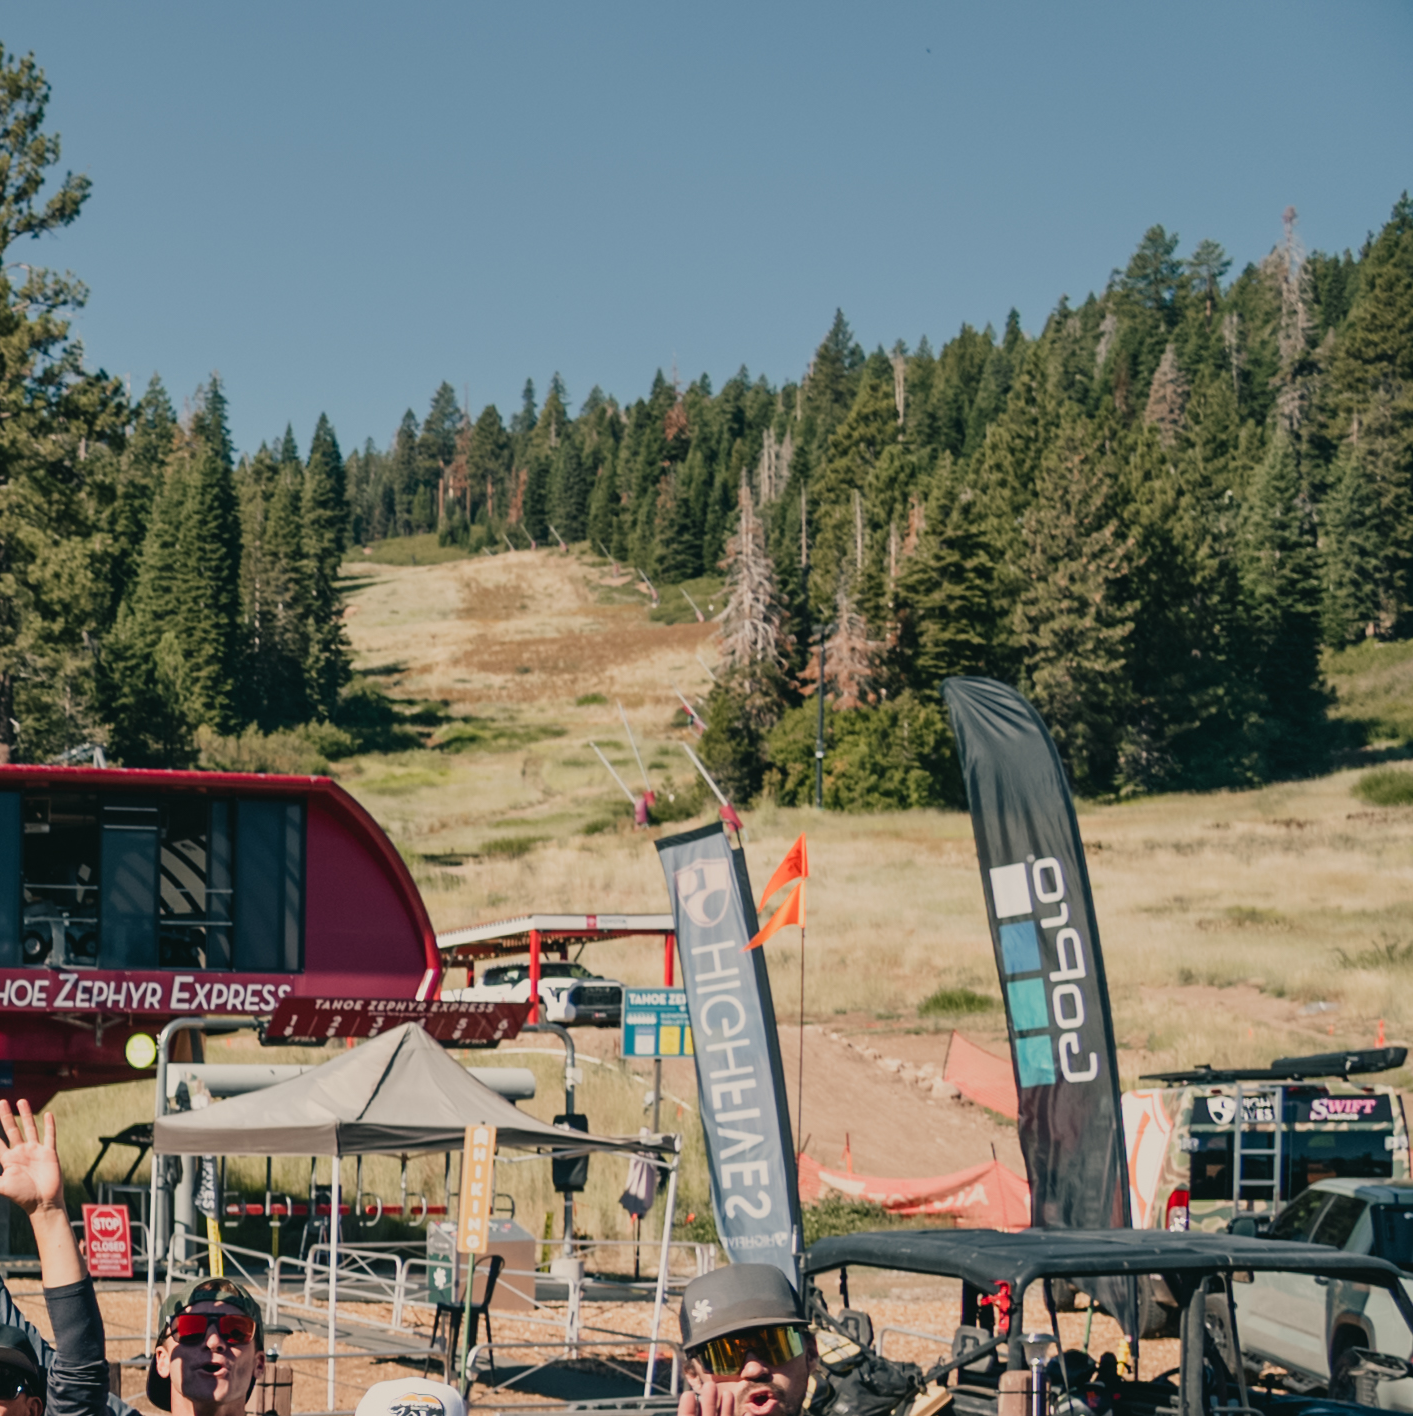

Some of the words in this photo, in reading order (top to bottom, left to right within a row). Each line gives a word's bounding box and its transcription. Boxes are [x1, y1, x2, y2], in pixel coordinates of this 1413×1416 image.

[53, 973, 162, 1009] ZEPHYR
[629, 993, 667, 1006] TAHOE
[314, 1000, 364, 1011] TAHOE
[368, 1001, 427, 1013] ZEPHYR
[430, 1003, 495, 1014] EXPRESS
[1309, 1098, 1376, 1121] SWIFT
[466, 1147, 487, 1249] HIKING
[93, 1217, 120, 1230] STOP
[91, 1241, 126, 1252] CLOSED
